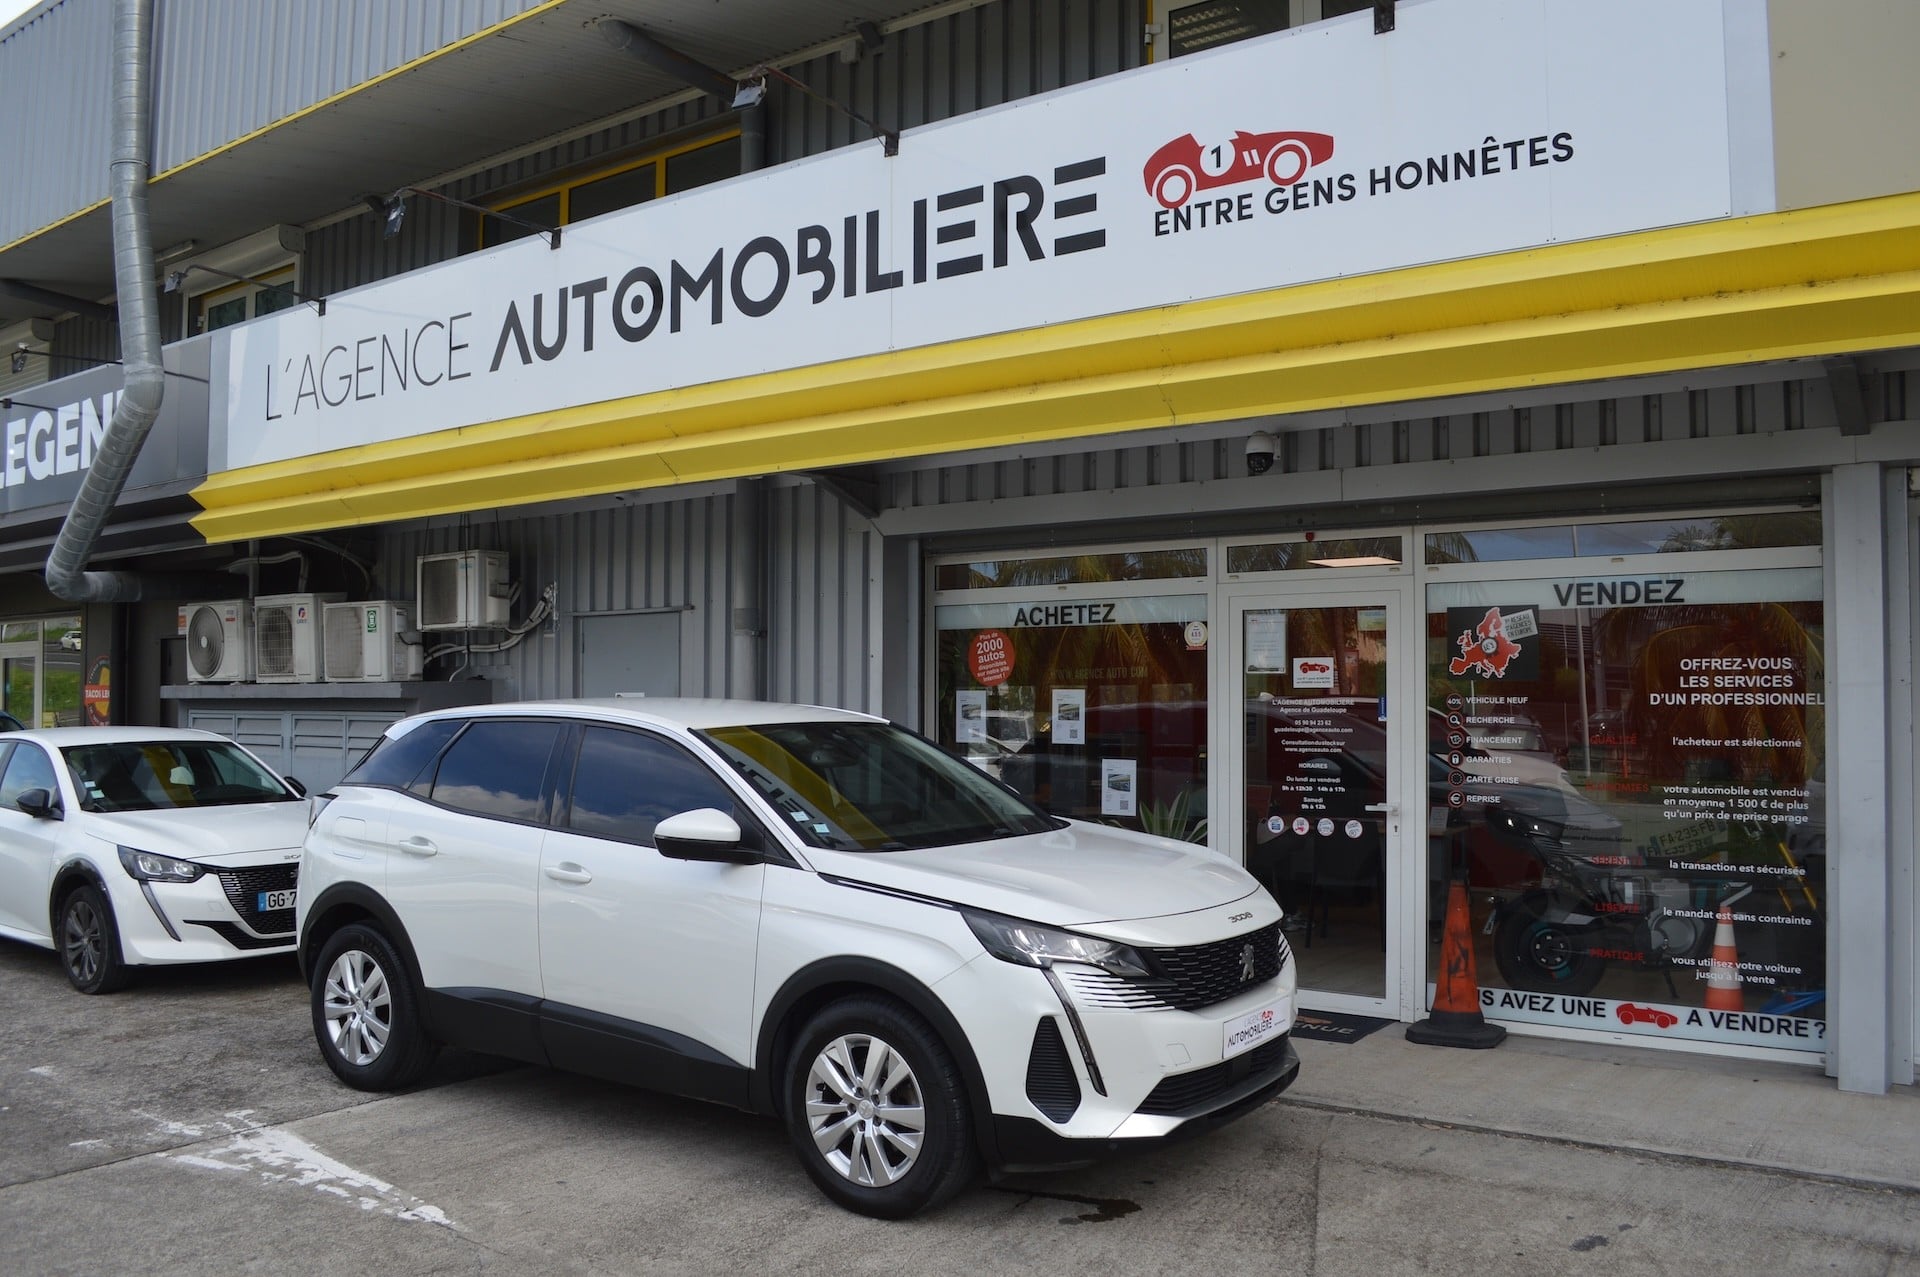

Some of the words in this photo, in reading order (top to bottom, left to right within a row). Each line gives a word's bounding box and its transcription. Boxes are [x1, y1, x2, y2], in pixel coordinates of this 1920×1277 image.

[1154, 192, 1254, 237] ENTRE
[1264, 173, 1357, 215] GENS
[1369, 132, 1575, 196] HONNÊTES
[266, 312, 472, 421] L'AGENCE
[489, 156, 1107, 373] AUTOMOBILIERE
[0, 389, 124, 489] EGEN
[1553, 580, 1685, 607] VENDEZ
[1014, 603, 1116, 626] ACHETEZ
[976, 637, 1004, 655] 2000
[978, 650, 1005, 664] autos
[1679, 657, 1793, 671] OFFREZ-VOUS
[1679, 675, 1710, 688] LES
[1713, 674, 1794, 688] SERVICES
[1506, 696, 1529, 704] NEUF
[1650, 693, 1686, 705] D'UN
[1690, 692, 1825, 706] PROFESSIONNEL
[1280, 707, 1302, 715] Agence
[1466, 716, 1516, 724] RECHERCHE
[1466, 735, 1522, 744] FINANCEMENT
[1672, 736, 1722, 747] l'acheteur
[1724, 738, 1740, 747] est
[1742, 736, 1802, 748] sélectionné
[1466, 755, 1512, 764] GARANTIES
[1466, 775, 1493, 783] CARTE
[1494, 776, 1519, 784] GRISE
[1663, 786, 1689, 794] votre
[1691, 785, 1750, 796] automobile
[1752, 788, 1768, 797] est
[1770, 787, 1810, 798] vendue
[1466, 795, 1501, 804] REPRISE
[1679, 799, 1726, 809] moyenne
[1728, 798, 1734, 807] 1
[1737, 799, 1758, 808] 500
[1760, 799, 1768, 809] €
[1770, 799, 1784, 809] de
[1786, 800, 1809, 812] plus
[1663, 809, 1692, 820] qu'un
[1694, 810, 1714, 821] prix
[1716, 810, 1730, 820] de
[1732, 811, 1769, 823] reprise
[1770, 815, 1809, 825] garage
[1669, 859, 1679, 869] la
[1681, 861, 1737, 873] transaction
[1739, 865, 1755, 874] est
[1757, 864, 1806, 876] sécurisée
[1227, 911, 1254, 924] 3008
[1663, 906, 1673, 916] le
[1675, 908, 1714, 919] mandat
[1716, 912, 1731, 921] est
[1733, 912, 1756, 922] sans
[1758, 914, 1812, 926] contrainte
[1671, 956, 1696, 966] vous
[1697, 957, 1734, 969] utilisez
[1736, 961, 1763, 971] votre
[1764, 962, 1802, 975] voiture
[1695, 969, 1732, 983] jusqu'à
[1734, 971, 1744, 982] la
[1746, 974, 1776, 985] vente
[1500, 991, 1555, 1013] AVEZ
[1561, 998, 1606, 1018] UNE
[1686, 1009, 1704, 1027] A
[1708, 1010, 1809, 1038] VENDRE
